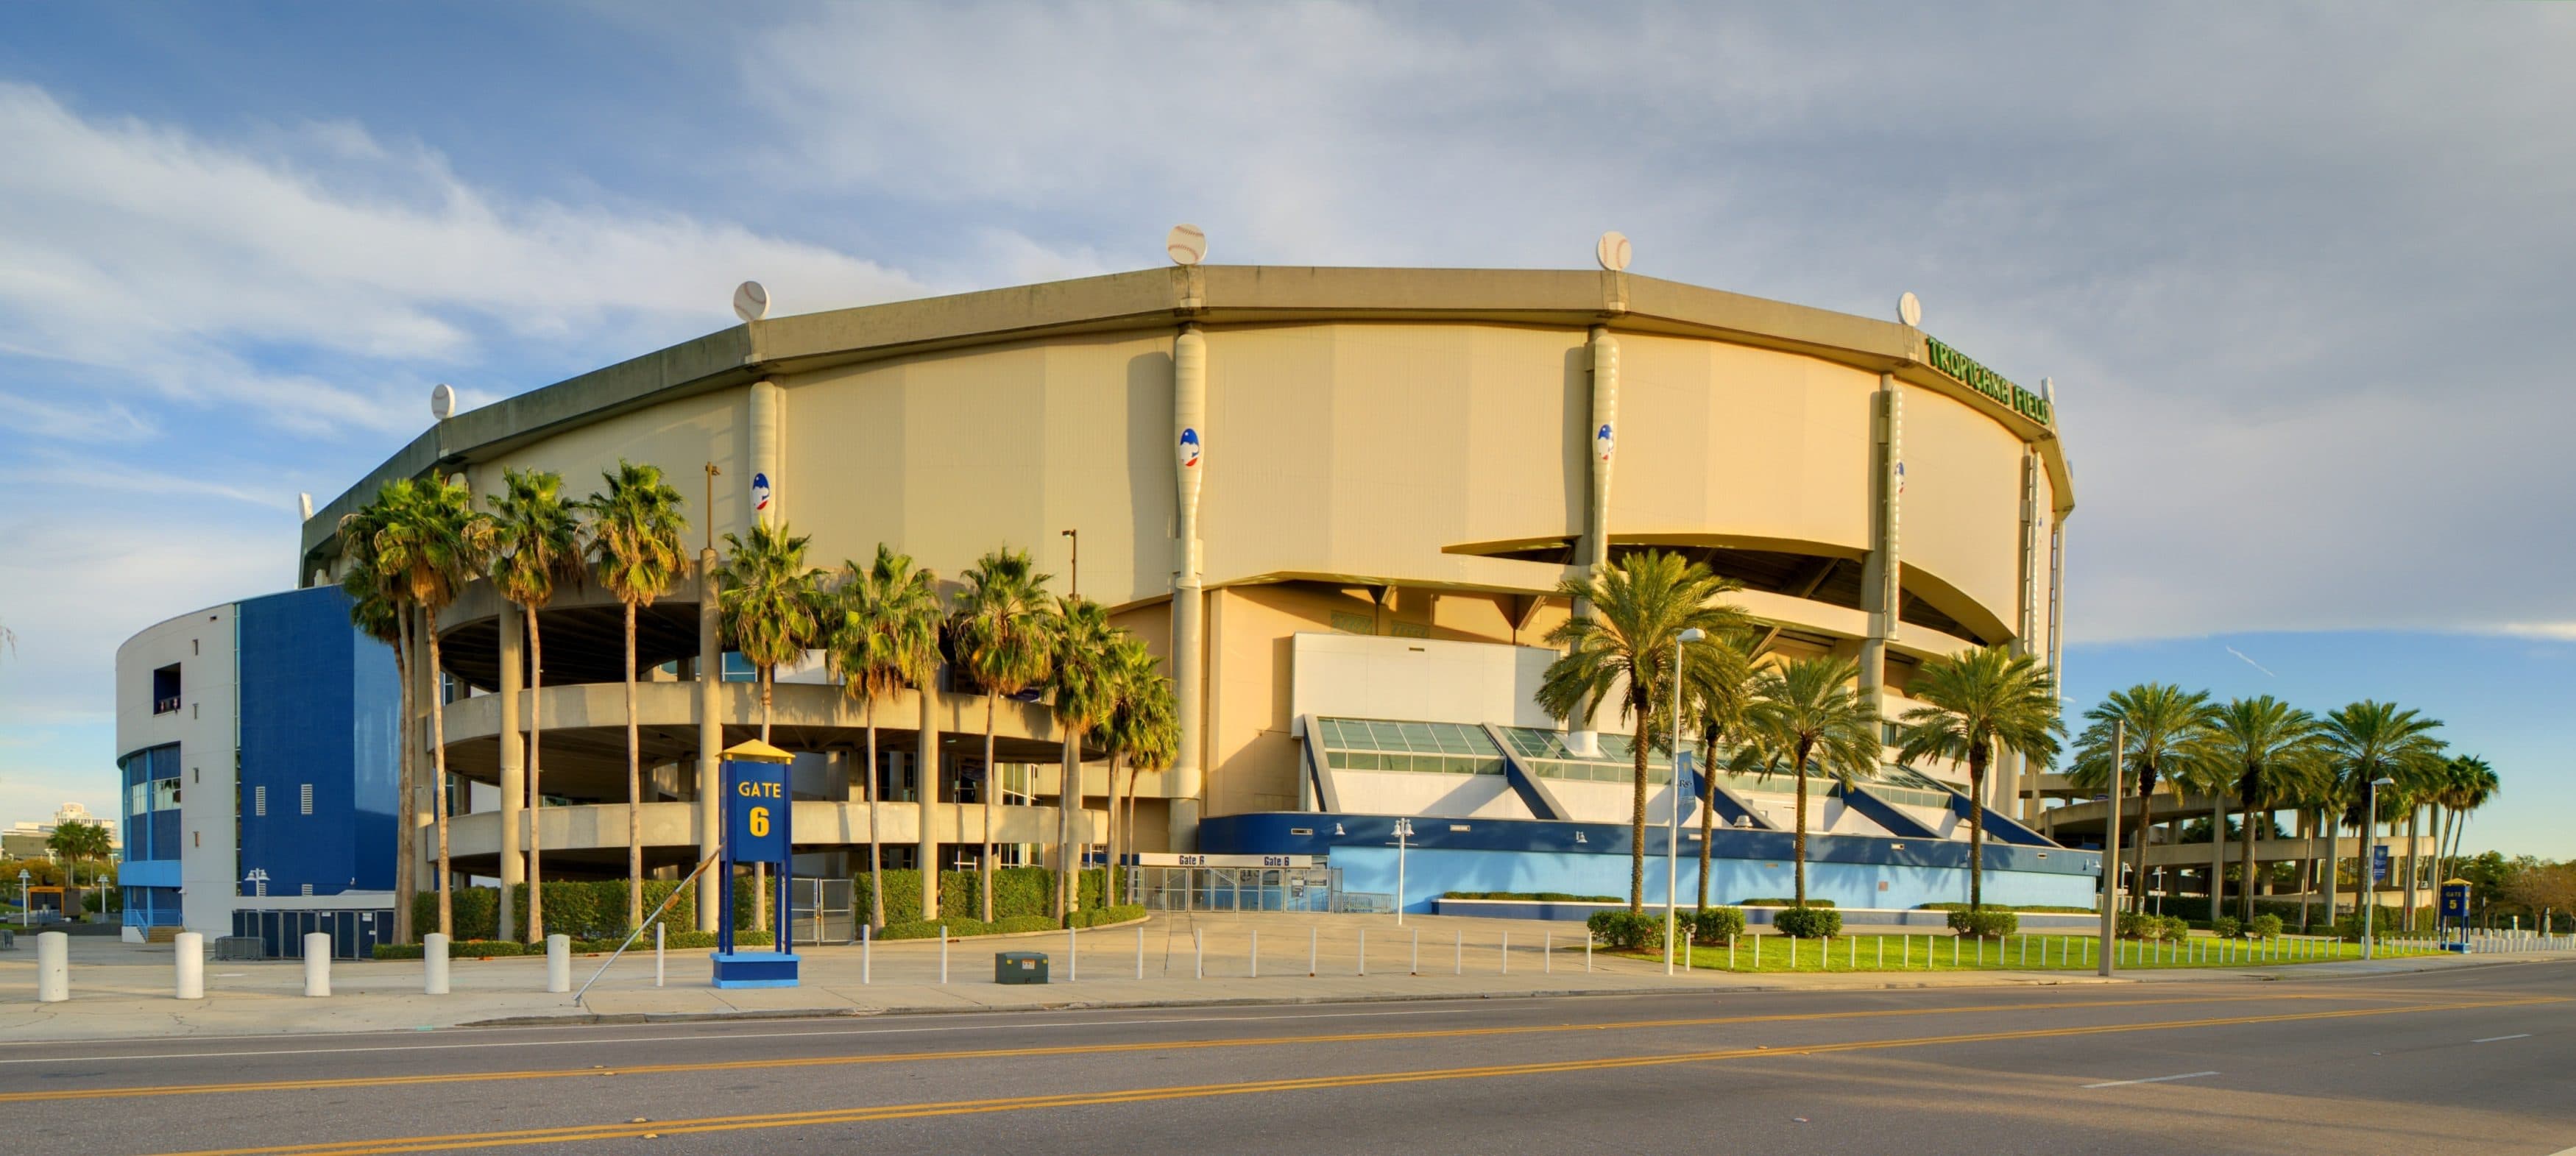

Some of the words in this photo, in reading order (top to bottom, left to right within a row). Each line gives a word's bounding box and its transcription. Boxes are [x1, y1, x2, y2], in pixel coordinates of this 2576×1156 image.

[1926, 336, 2010, 405] TROPICANA
[2013, 383, 2050, 425] FIELD
[737, 781, 782, 798] GATE
[749, 806, 770, 837] 6
[1179, 855, 1196, 865] Gate
[1264, 856, 1281, 866] Gate
[1284, 856, 1289, 866] 6
[2449, 899, 2458, 909] 5
